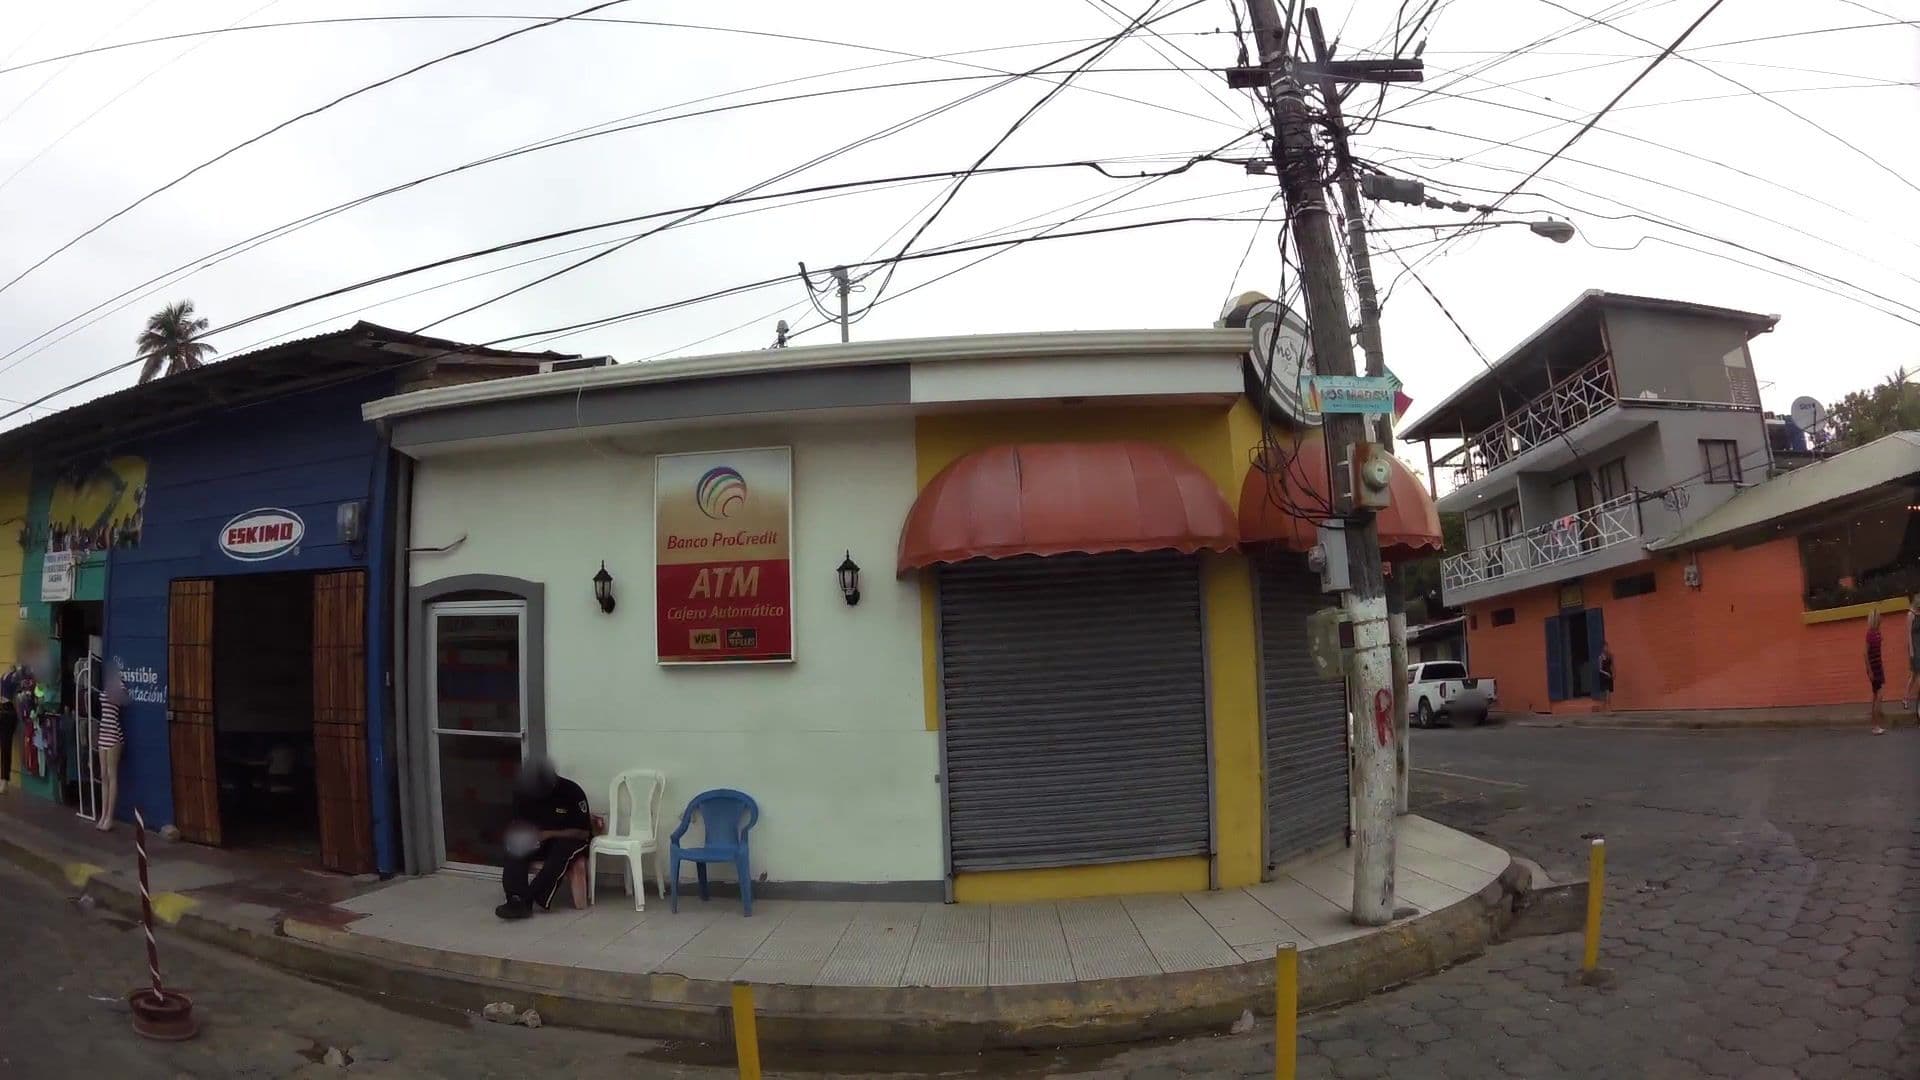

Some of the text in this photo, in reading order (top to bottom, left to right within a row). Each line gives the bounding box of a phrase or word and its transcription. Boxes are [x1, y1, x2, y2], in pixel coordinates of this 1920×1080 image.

[227, 522, 294, 545] ESKIMO
[667, 530, 778, 550] Banco ProCredit
[688, 566, 760, 599] ATM
[667, 602, 785, 624] Cajero Automático
[694, 632, 717, 644] VISA
